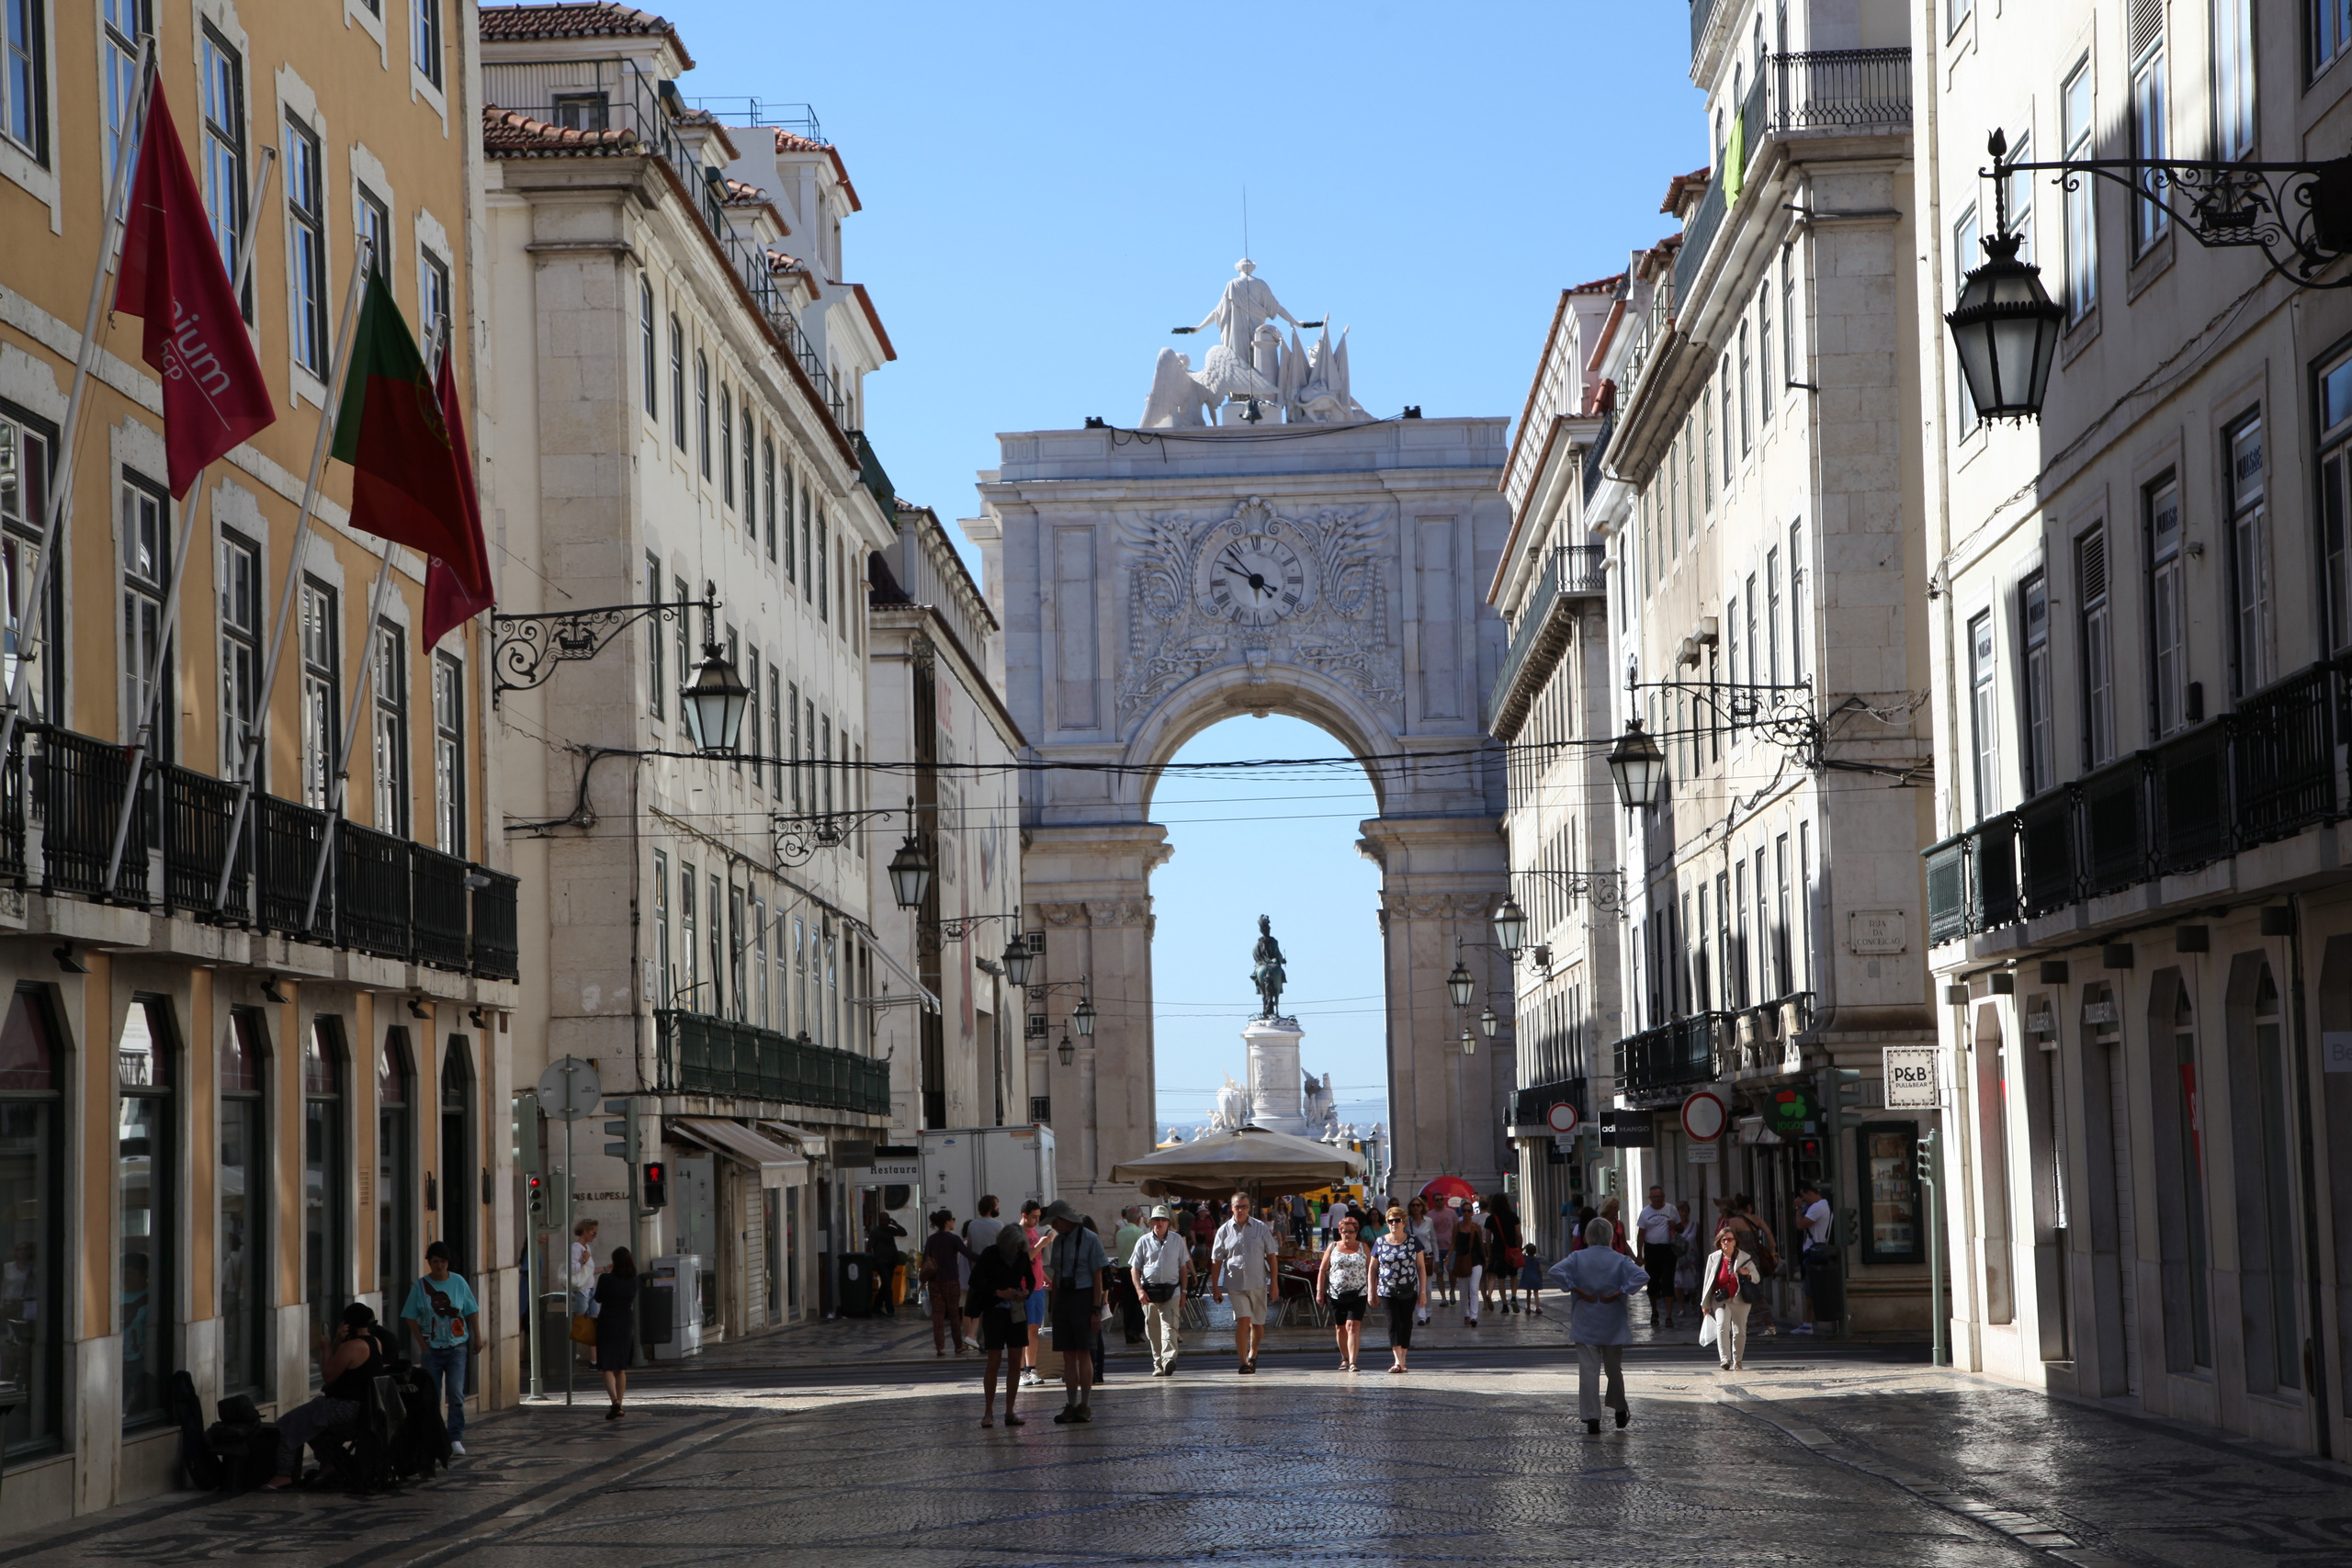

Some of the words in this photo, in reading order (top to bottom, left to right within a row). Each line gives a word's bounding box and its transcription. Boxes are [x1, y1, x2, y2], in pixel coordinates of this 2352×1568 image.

[1869, 919, 1886, 928] RUA
[1894, 1066, 1927, 1081] P&B
[1777, 1121, 1805, 1133] JOGOS
